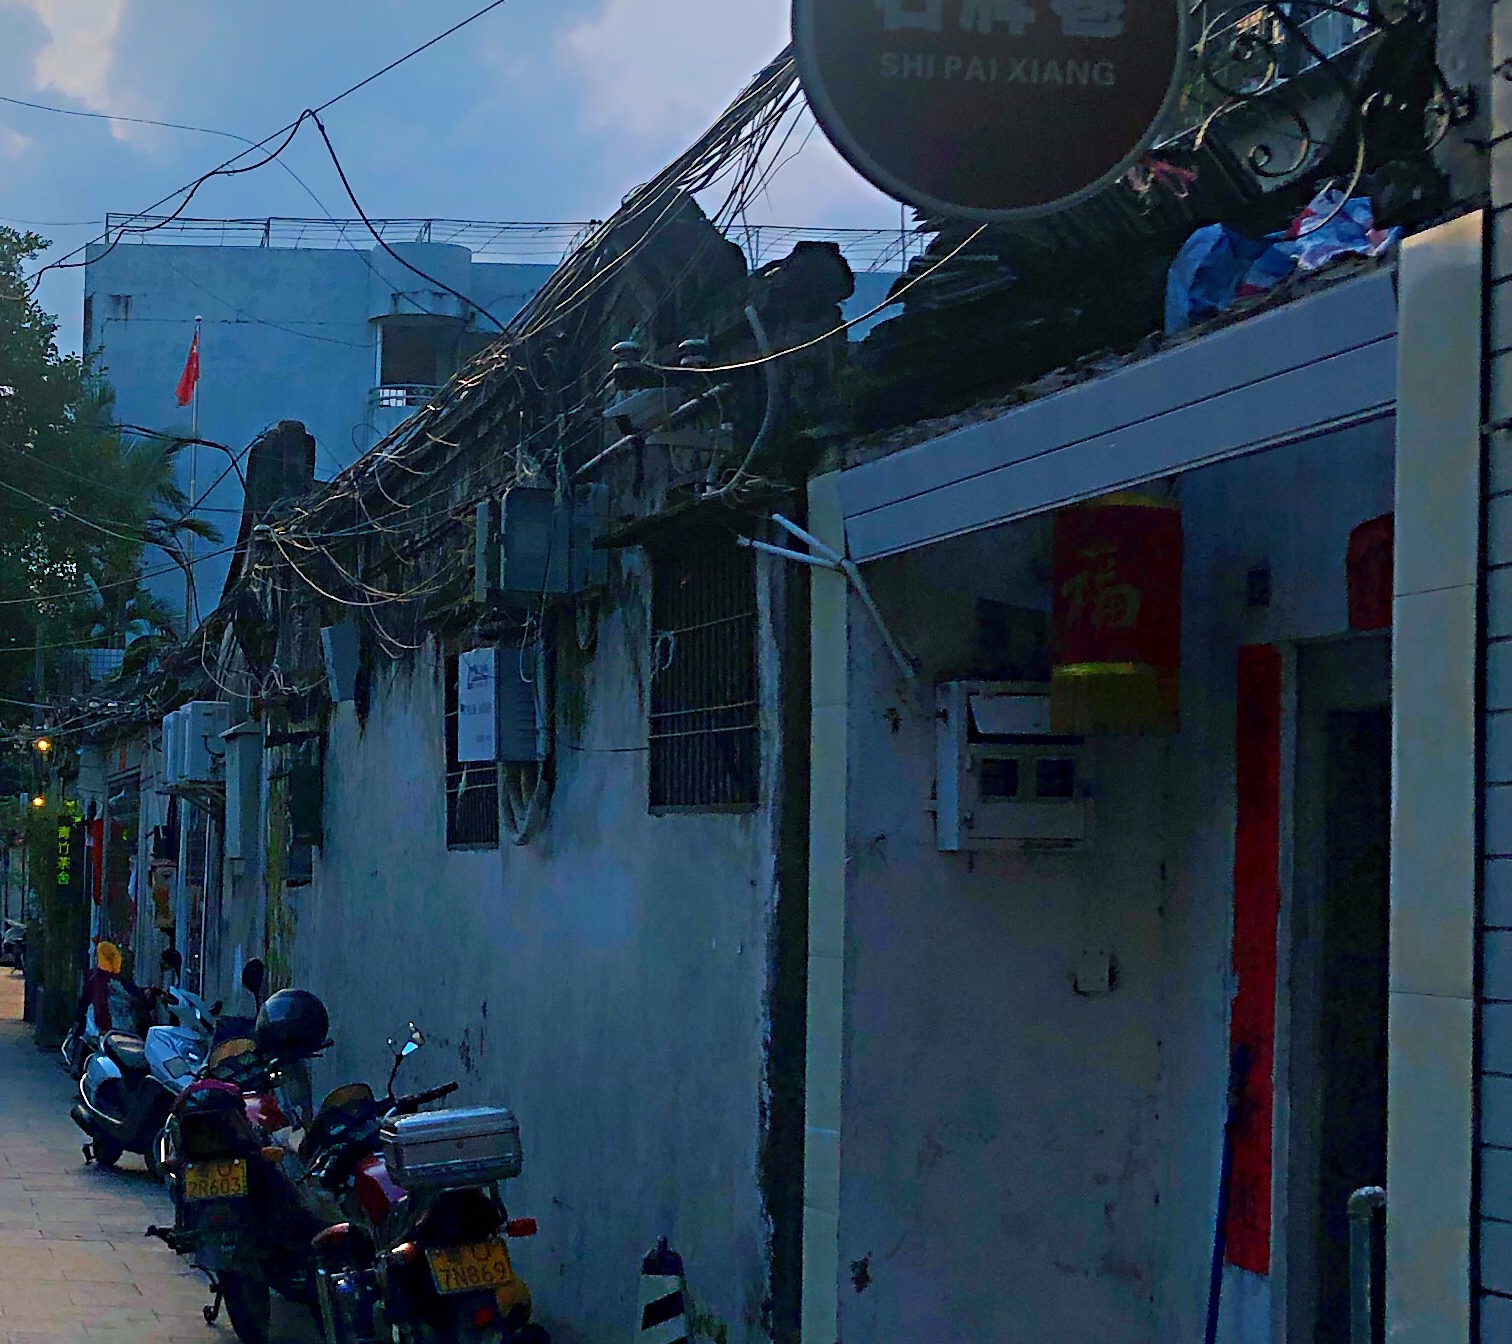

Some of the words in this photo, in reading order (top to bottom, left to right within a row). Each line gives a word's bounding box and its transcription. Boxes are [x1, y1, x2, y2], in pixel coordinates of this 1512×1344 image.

[880, 51, 934, 79] SHI
[944, 55, 998, 81] PAI
[1007, 57, 1116, 86] XIANG
